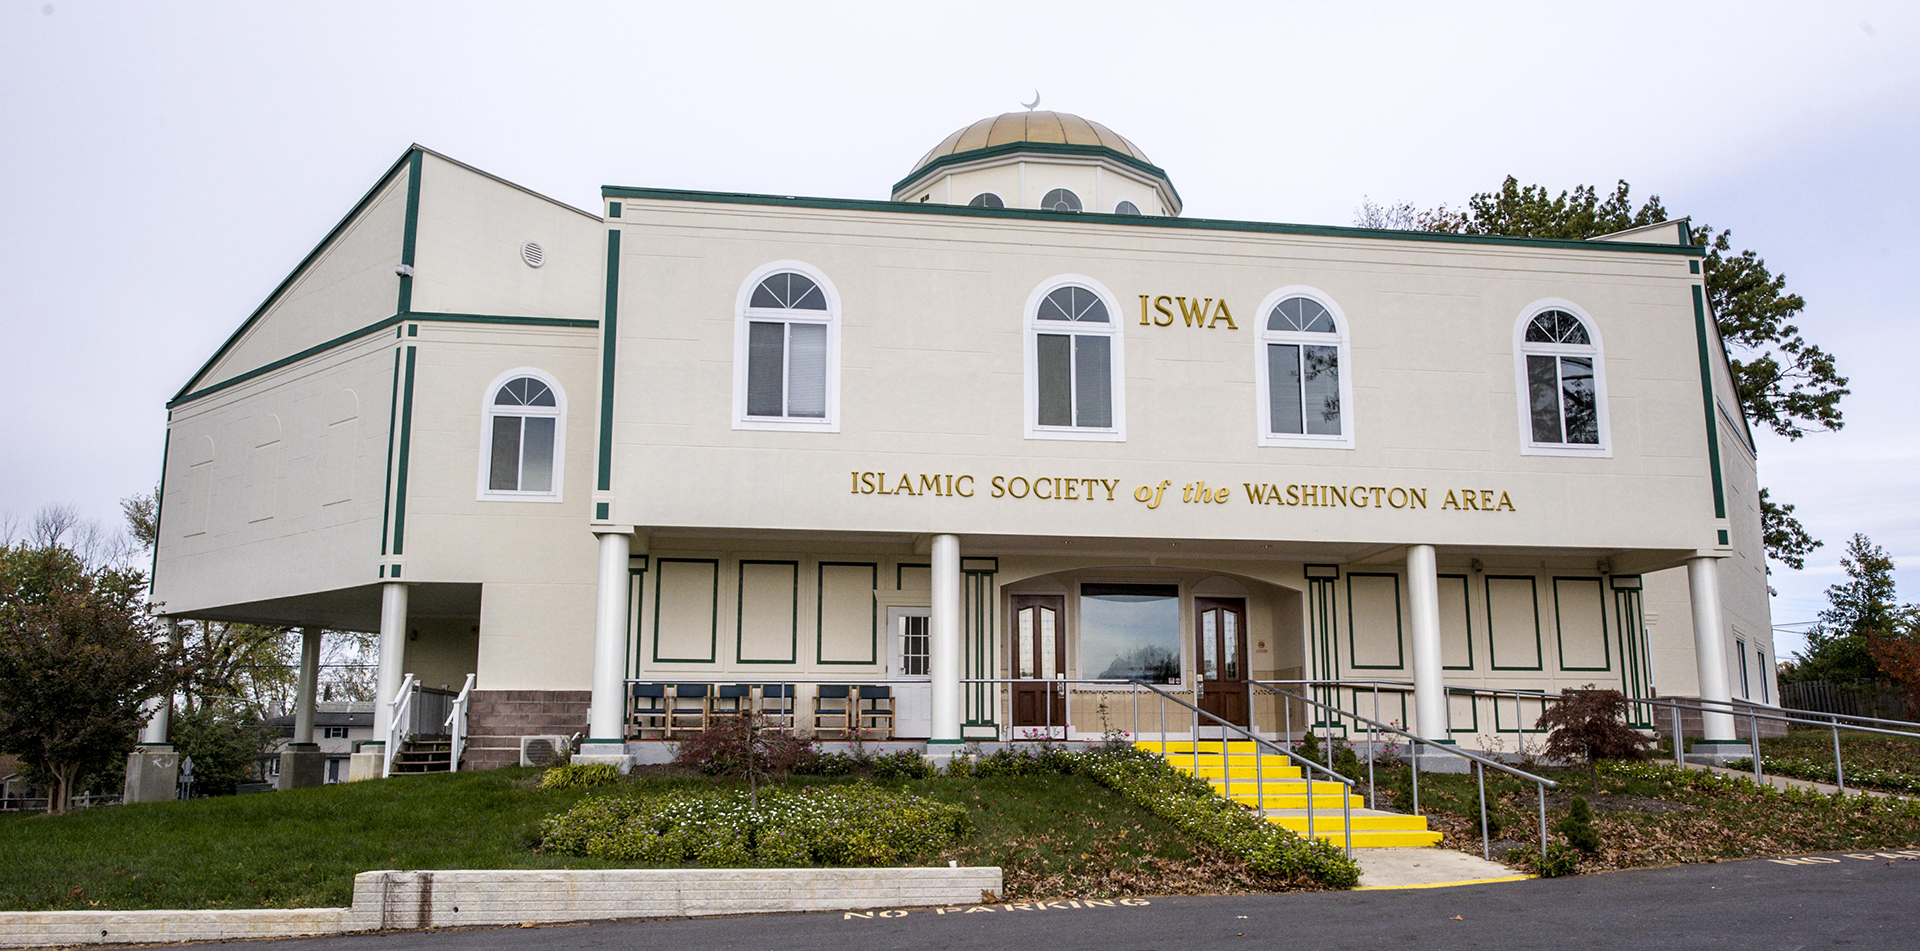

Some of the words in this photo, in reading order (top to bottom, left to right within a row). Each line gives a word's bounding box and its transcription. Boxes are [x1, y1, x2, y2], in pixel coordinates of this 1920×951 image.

[1138, 294, 1238, 330] ISWA
[850, 471, 975, 498] ISLAMIC
[990, 475, 1120, 502] SOCIETY
[1133, 478, 1172, 510] of
[1182, 480, 1231, 505] the
[1243, 482, 1427, 509] WASHINGTON
[1441, 488, 1516, 512] AREA
[843, 909, 909, 920] NO
[936, 897, 1151, 915] PARKING
